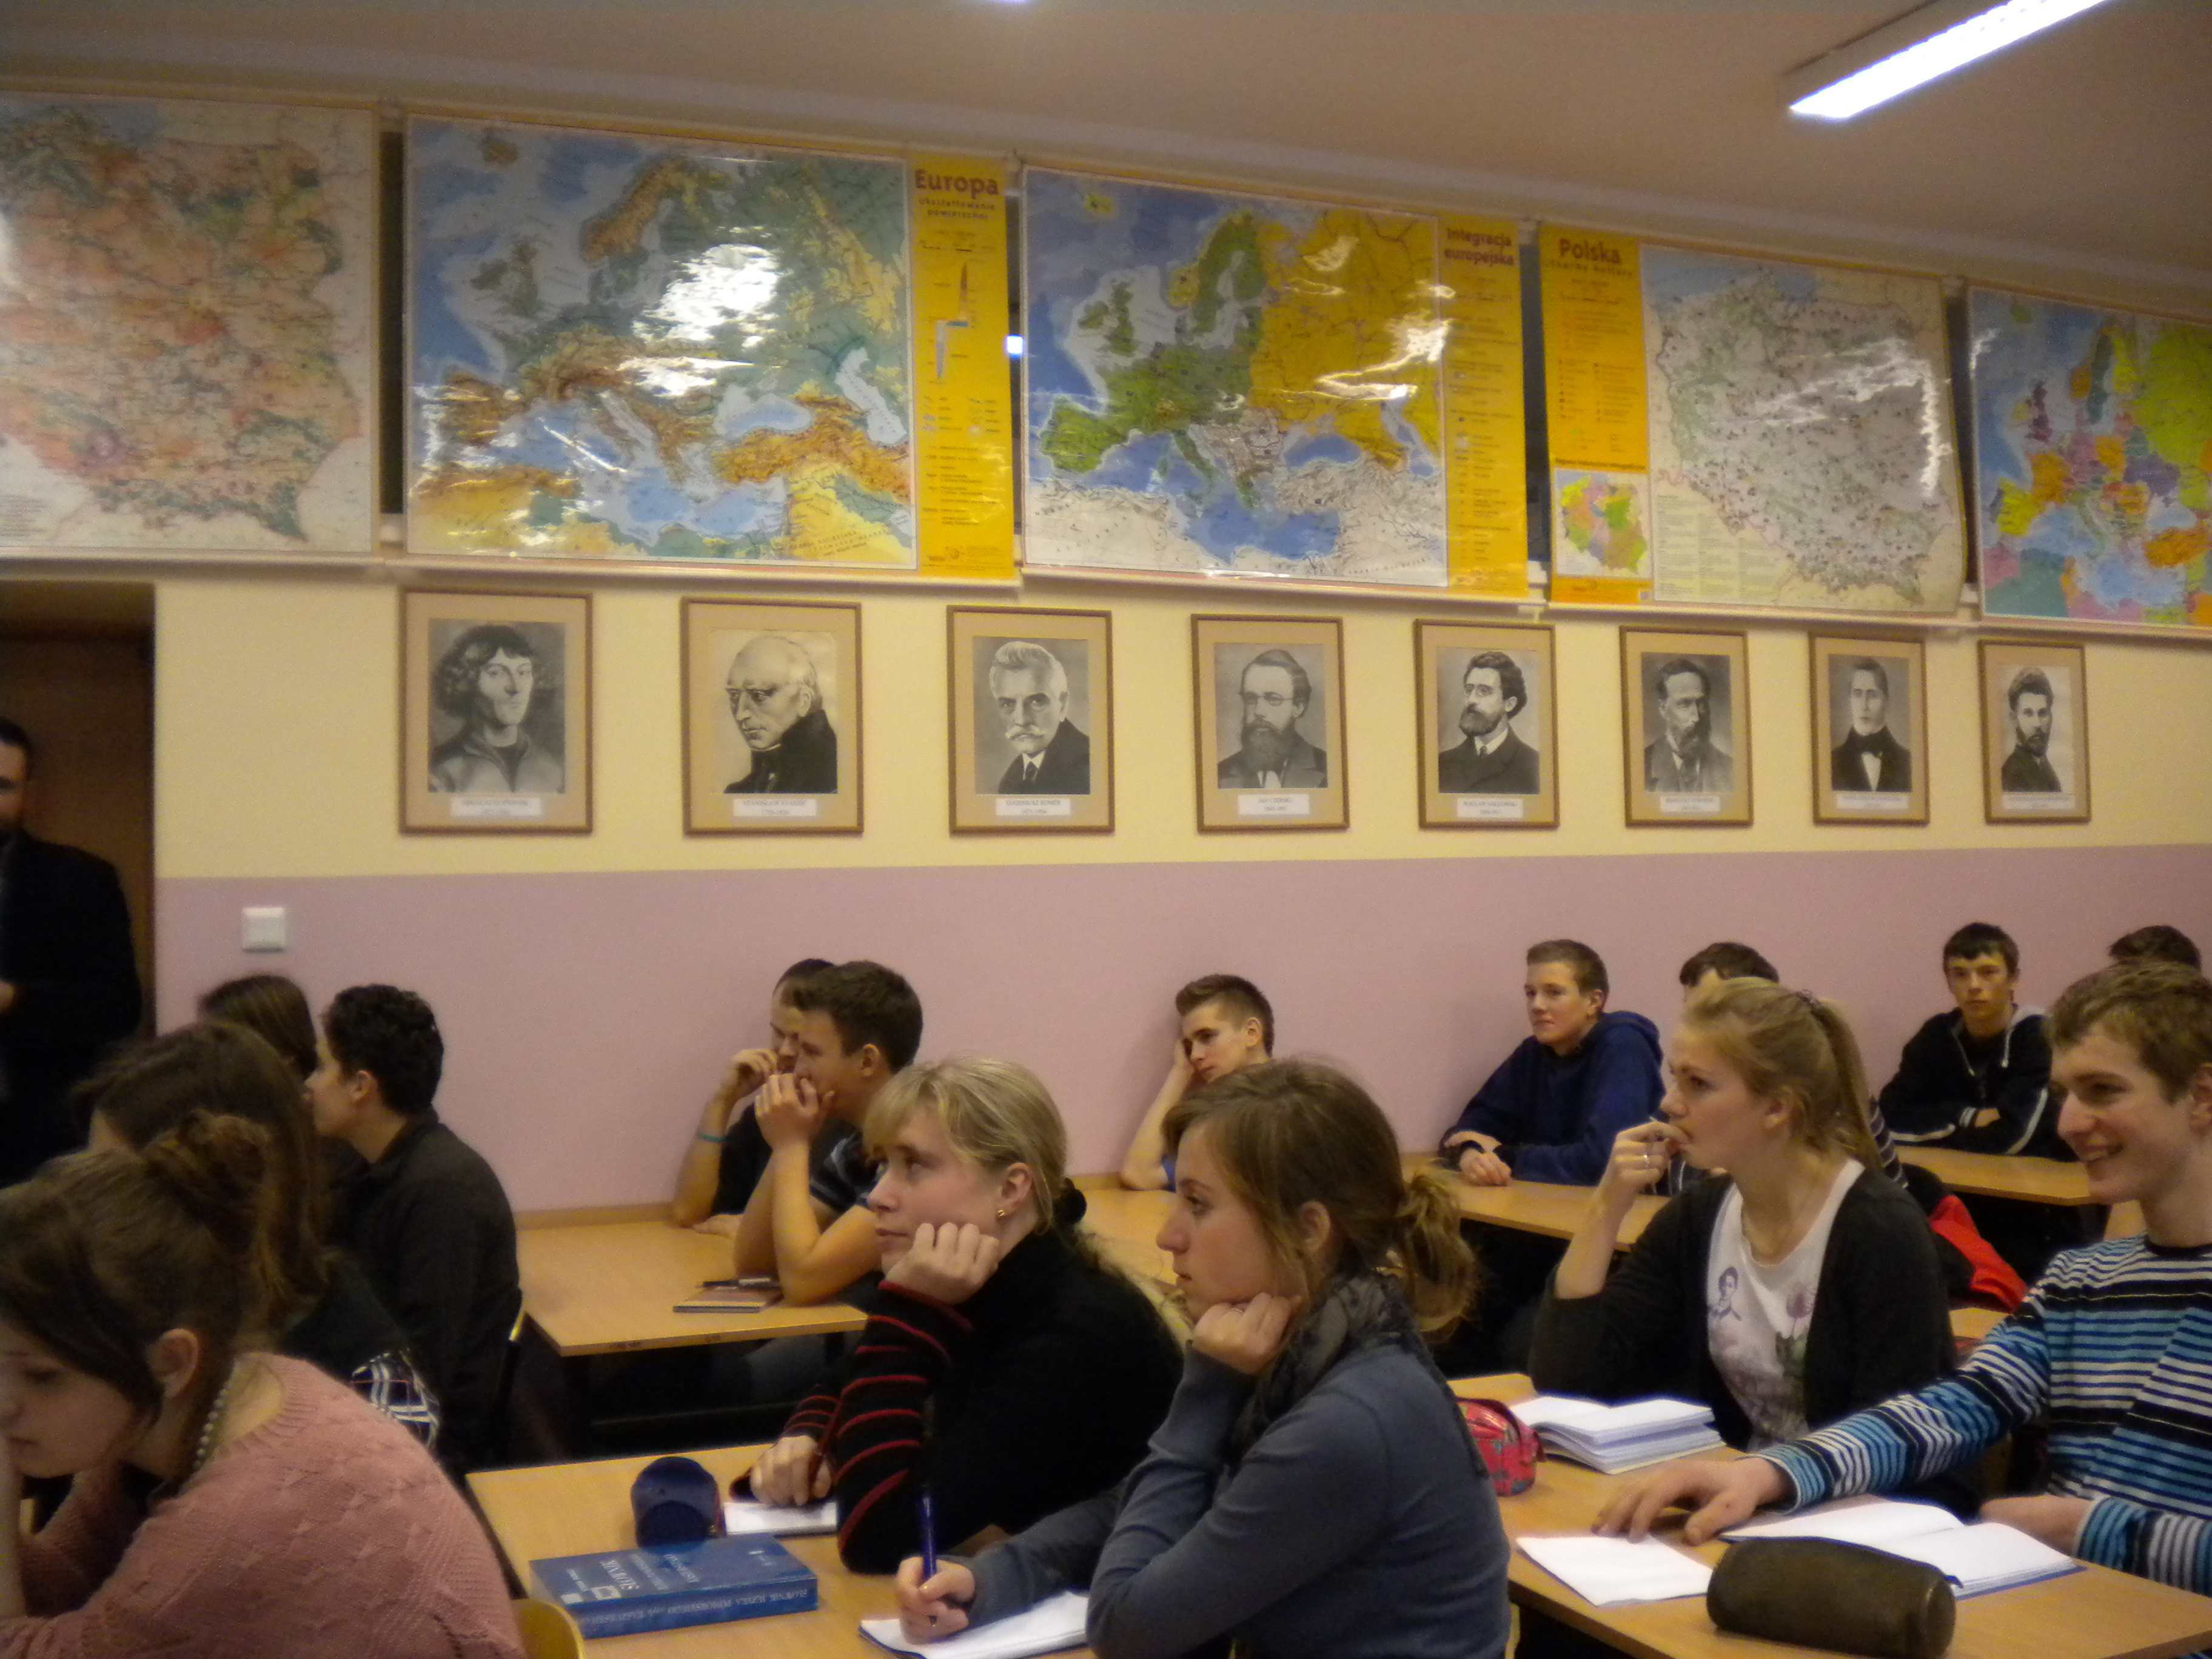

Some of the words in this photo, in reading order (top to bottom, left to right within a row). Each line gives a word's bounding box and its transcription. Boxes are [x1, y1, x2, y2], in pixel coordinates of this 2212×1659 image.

[915, 169, 999, 199] Europa
[1447, 228, 1512, 253] Integracja
[1559, 238, 1621, 263] Polska
[1444, 248, 1513, 267] europejska
